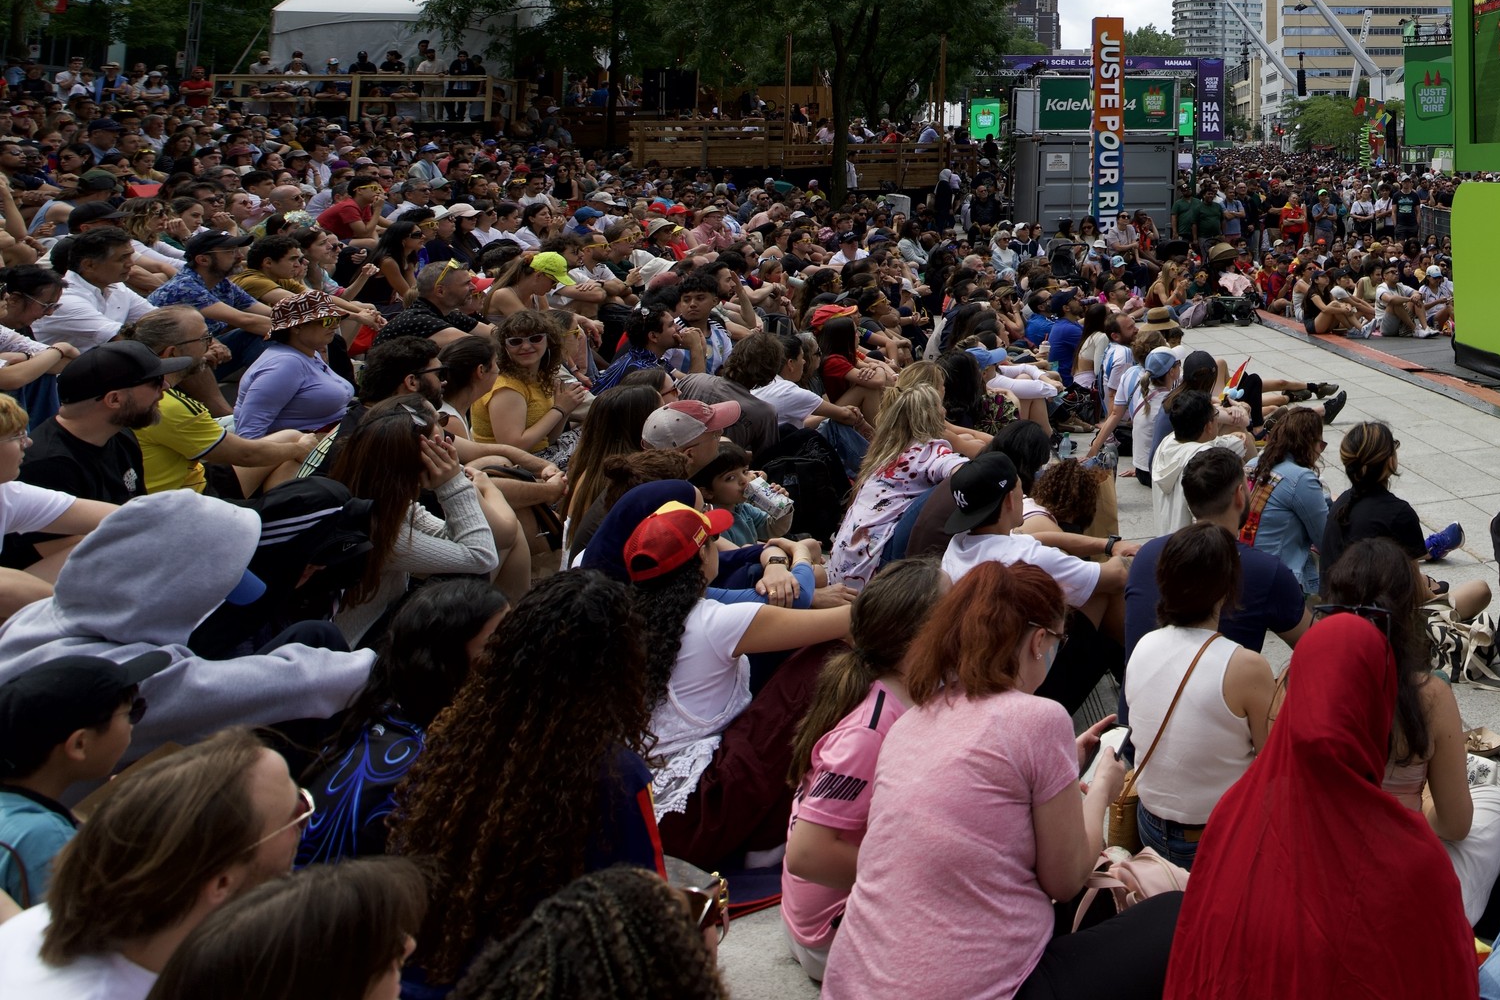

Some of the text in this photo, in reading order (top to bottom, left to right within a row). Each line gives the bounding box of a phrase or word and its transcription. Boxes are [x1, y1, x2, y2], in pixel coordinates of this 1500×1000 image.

[1051, 58, 1076, 66] SCÈNE
[1100, 31, 1120, 108] JUSTE
[1418, 87, 1447, 97] JUSTE
[1420, 96, 1446, 105] POUR
[1202, 102, 1220, 112] HA
[1422, 104, 1444, 113] RIRE
[1202, 112, 1220, 122] HA
[1202, 122, 1220, 132] HA
[1099, 115, 1120, 185] POUR
[1154, 145, 1167, 153] 356
